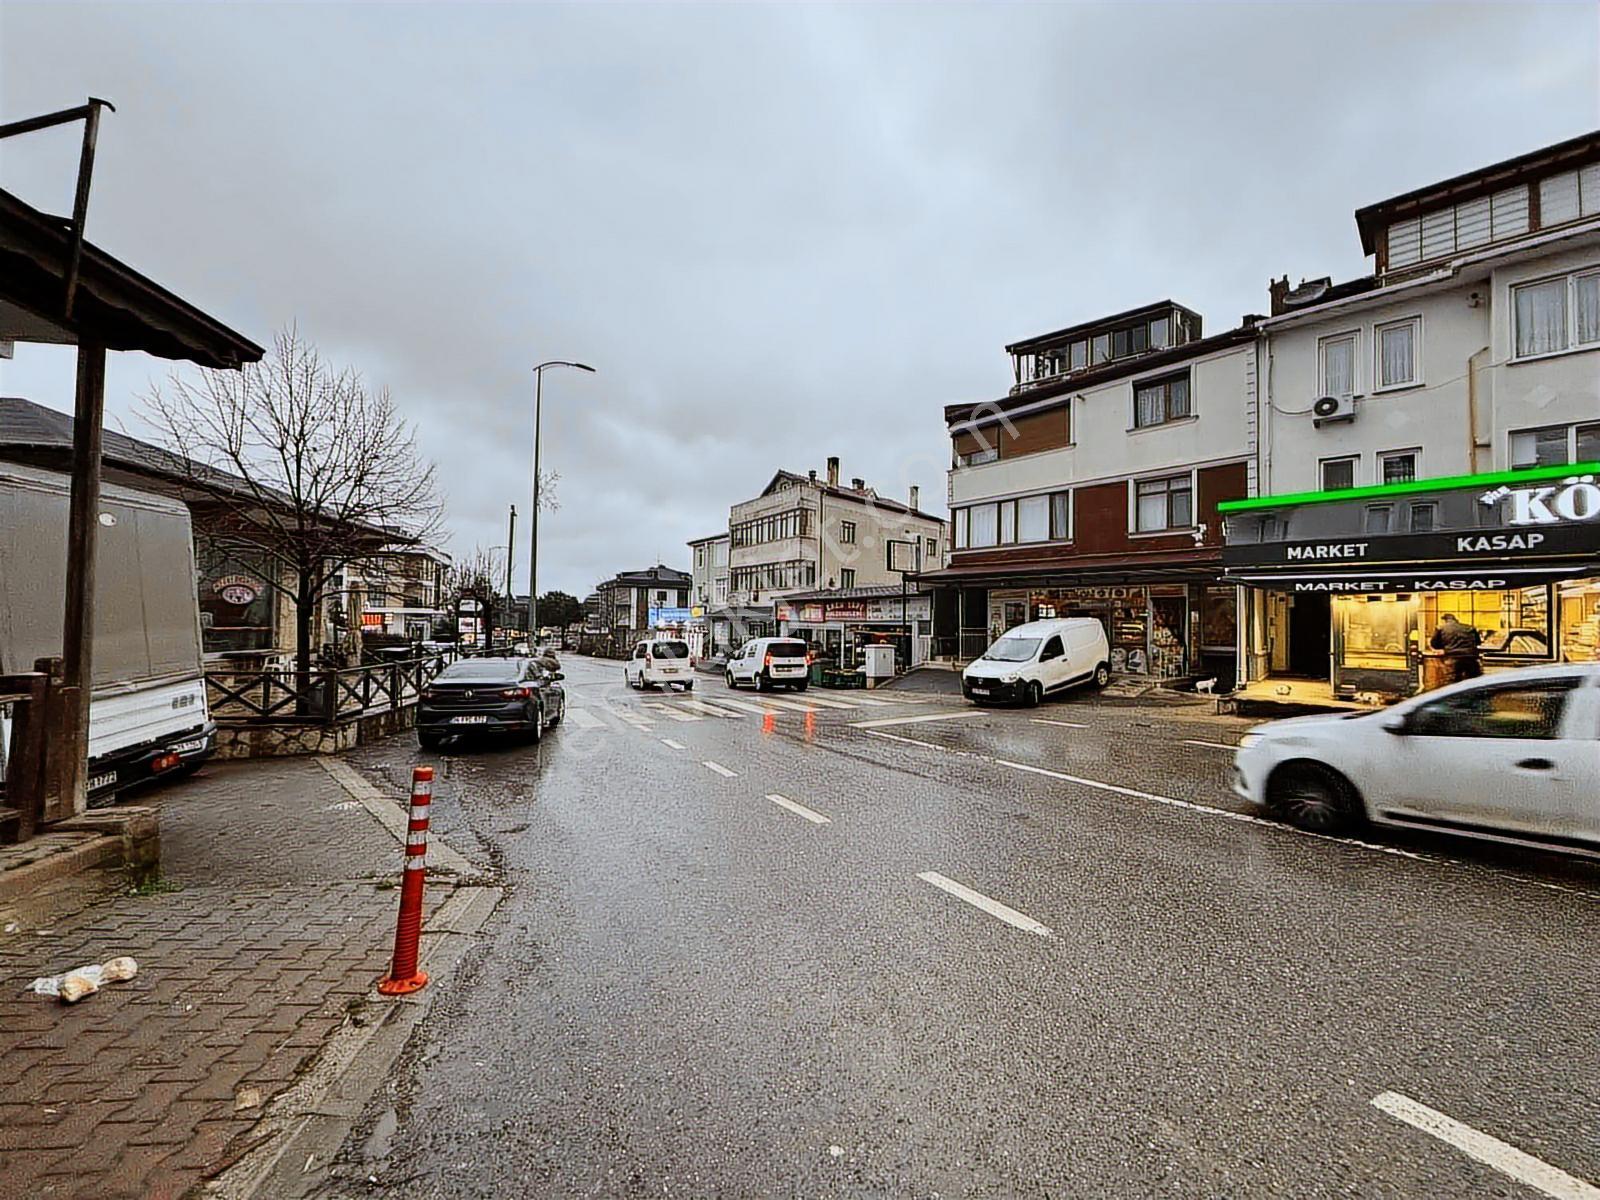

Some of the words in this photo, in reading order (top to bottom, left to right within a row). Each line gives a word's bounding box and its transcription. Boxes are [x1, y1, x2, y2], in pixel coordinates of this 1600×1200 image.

[1456, 534, 1544, 552] KASAP
[1286, 544, 1368, 561] MARKET
[1295, 582, 1388, 593] MARKET
[1414, 579, 1506, 591] KASAP
